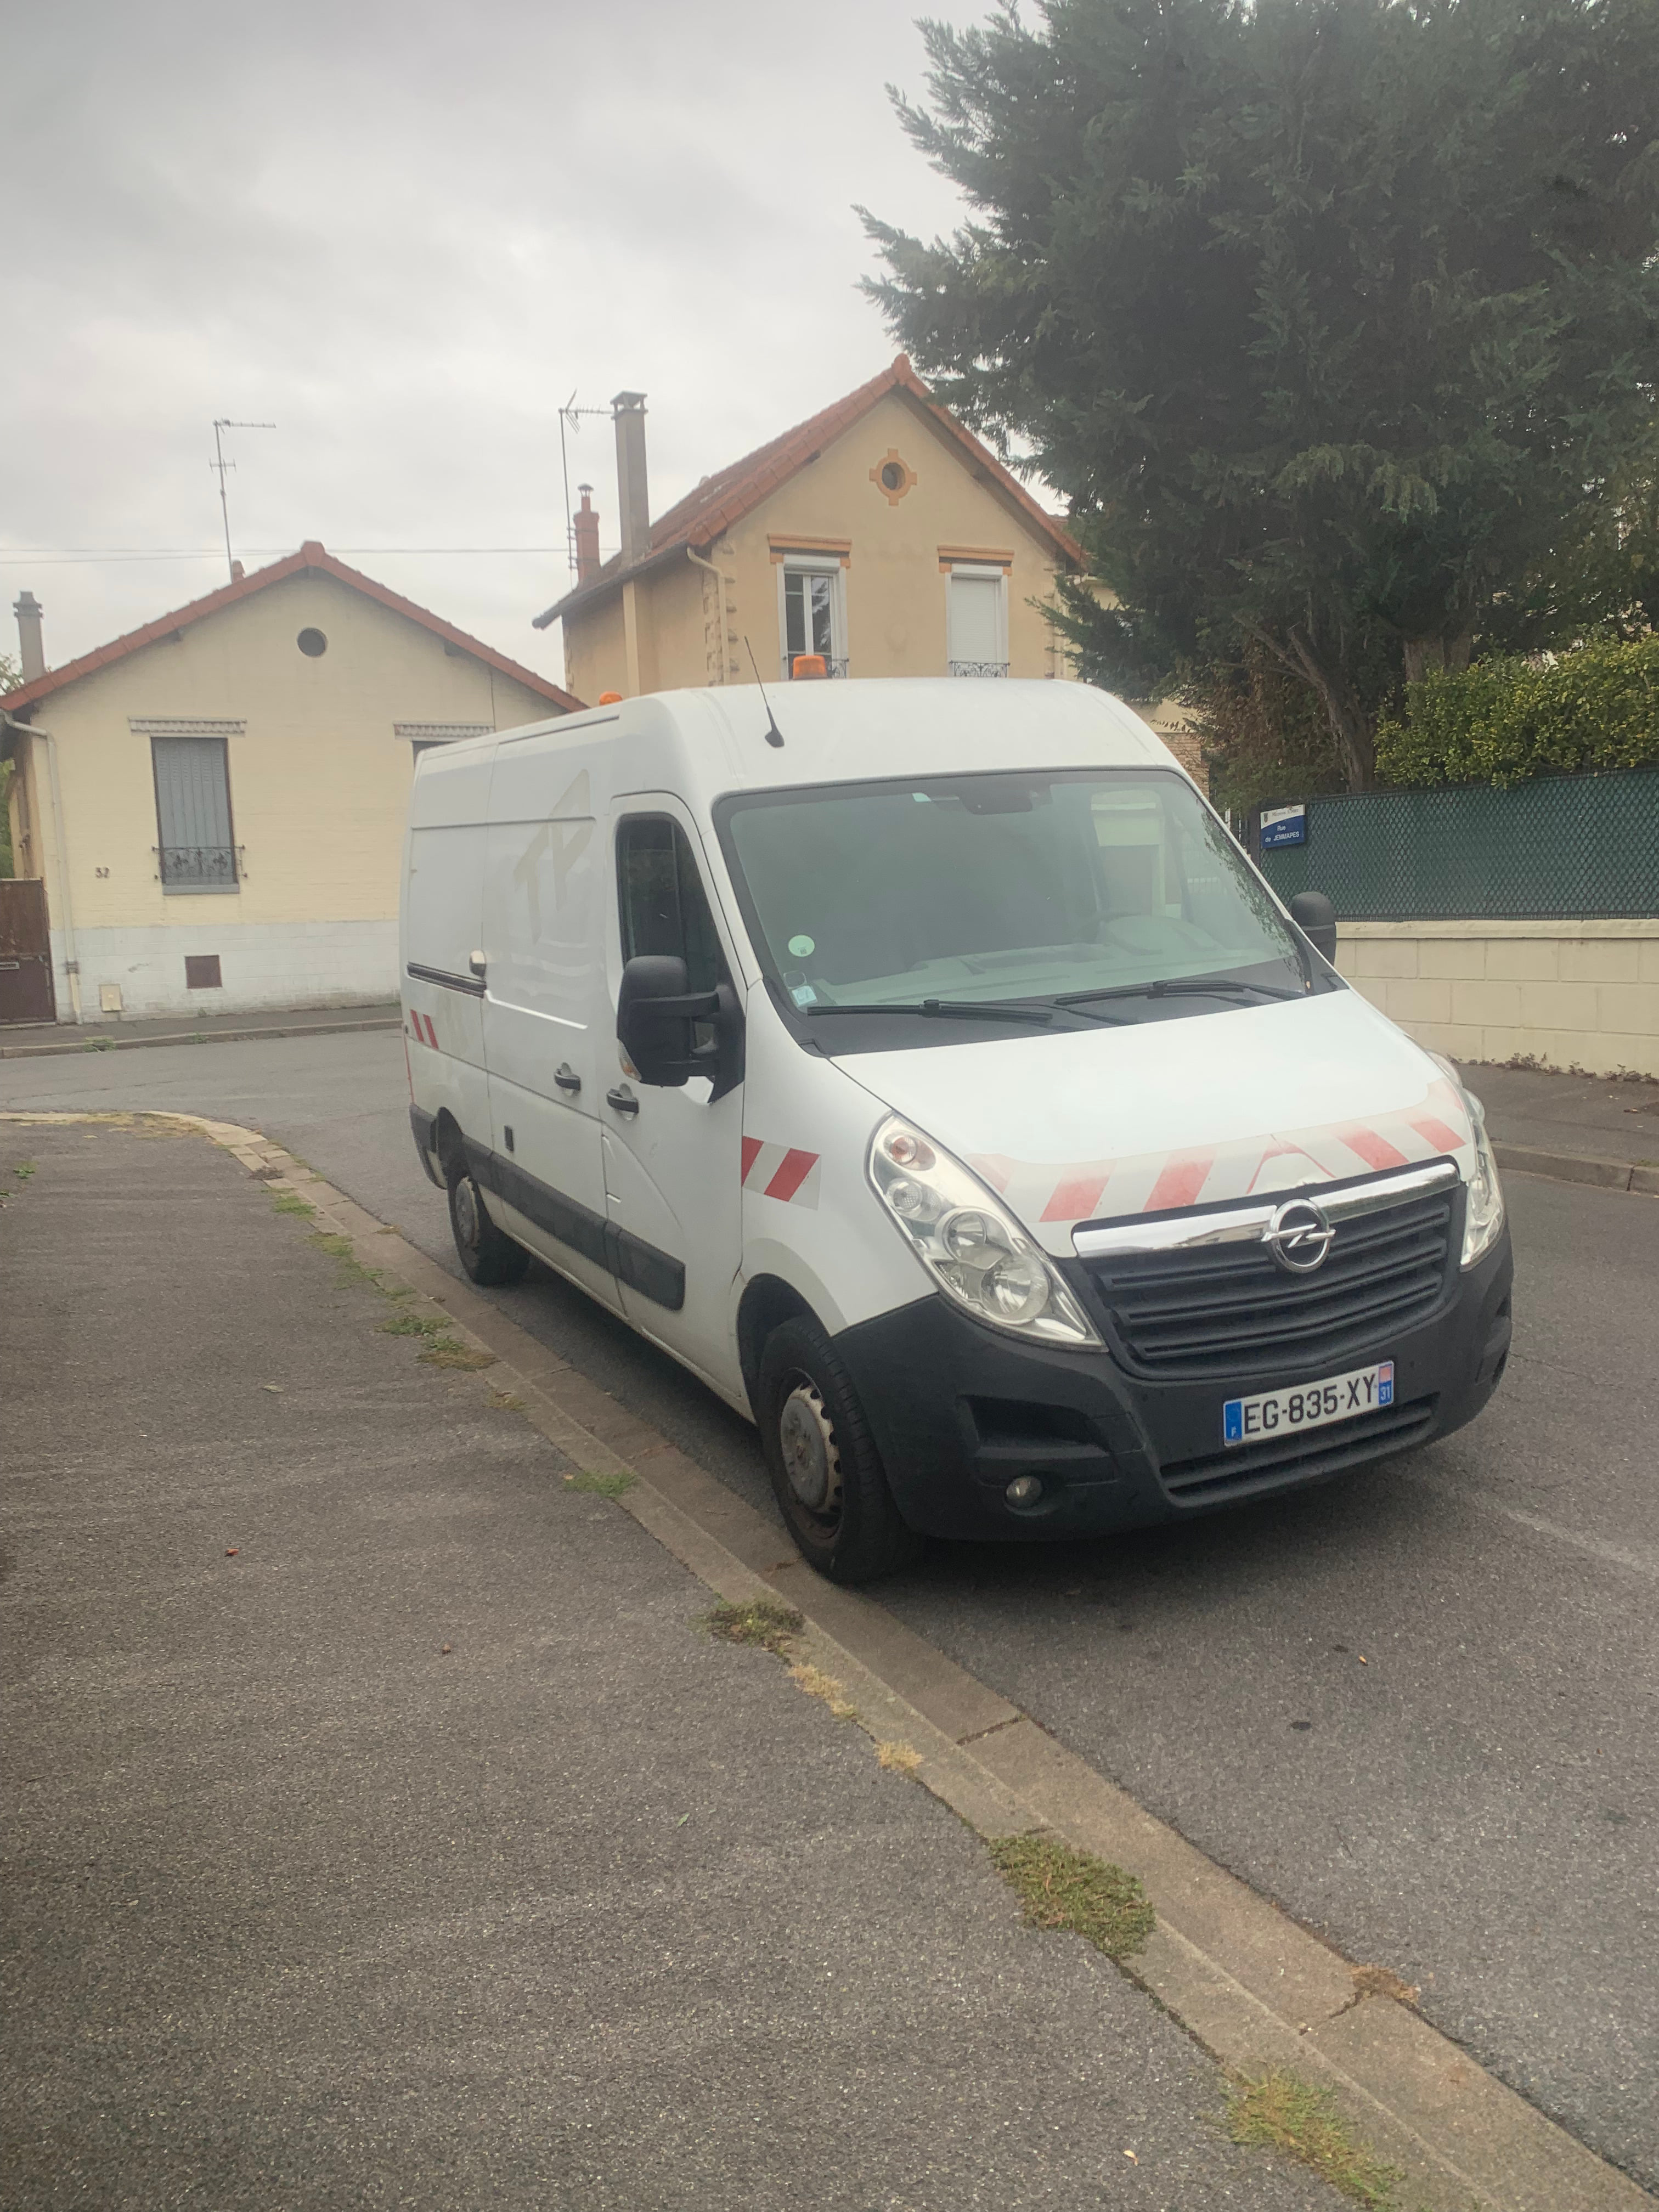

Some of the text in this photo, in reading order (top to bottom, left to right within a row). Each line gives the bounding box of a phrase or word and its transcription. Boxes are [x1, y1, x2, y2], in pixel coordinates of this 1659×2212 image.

[1273, 831, 1299, 841] JEMMAPES
[1244, 1374, 1375, 1434] EG-835-XY
[1380, 1386, 1391, 1400] 31
